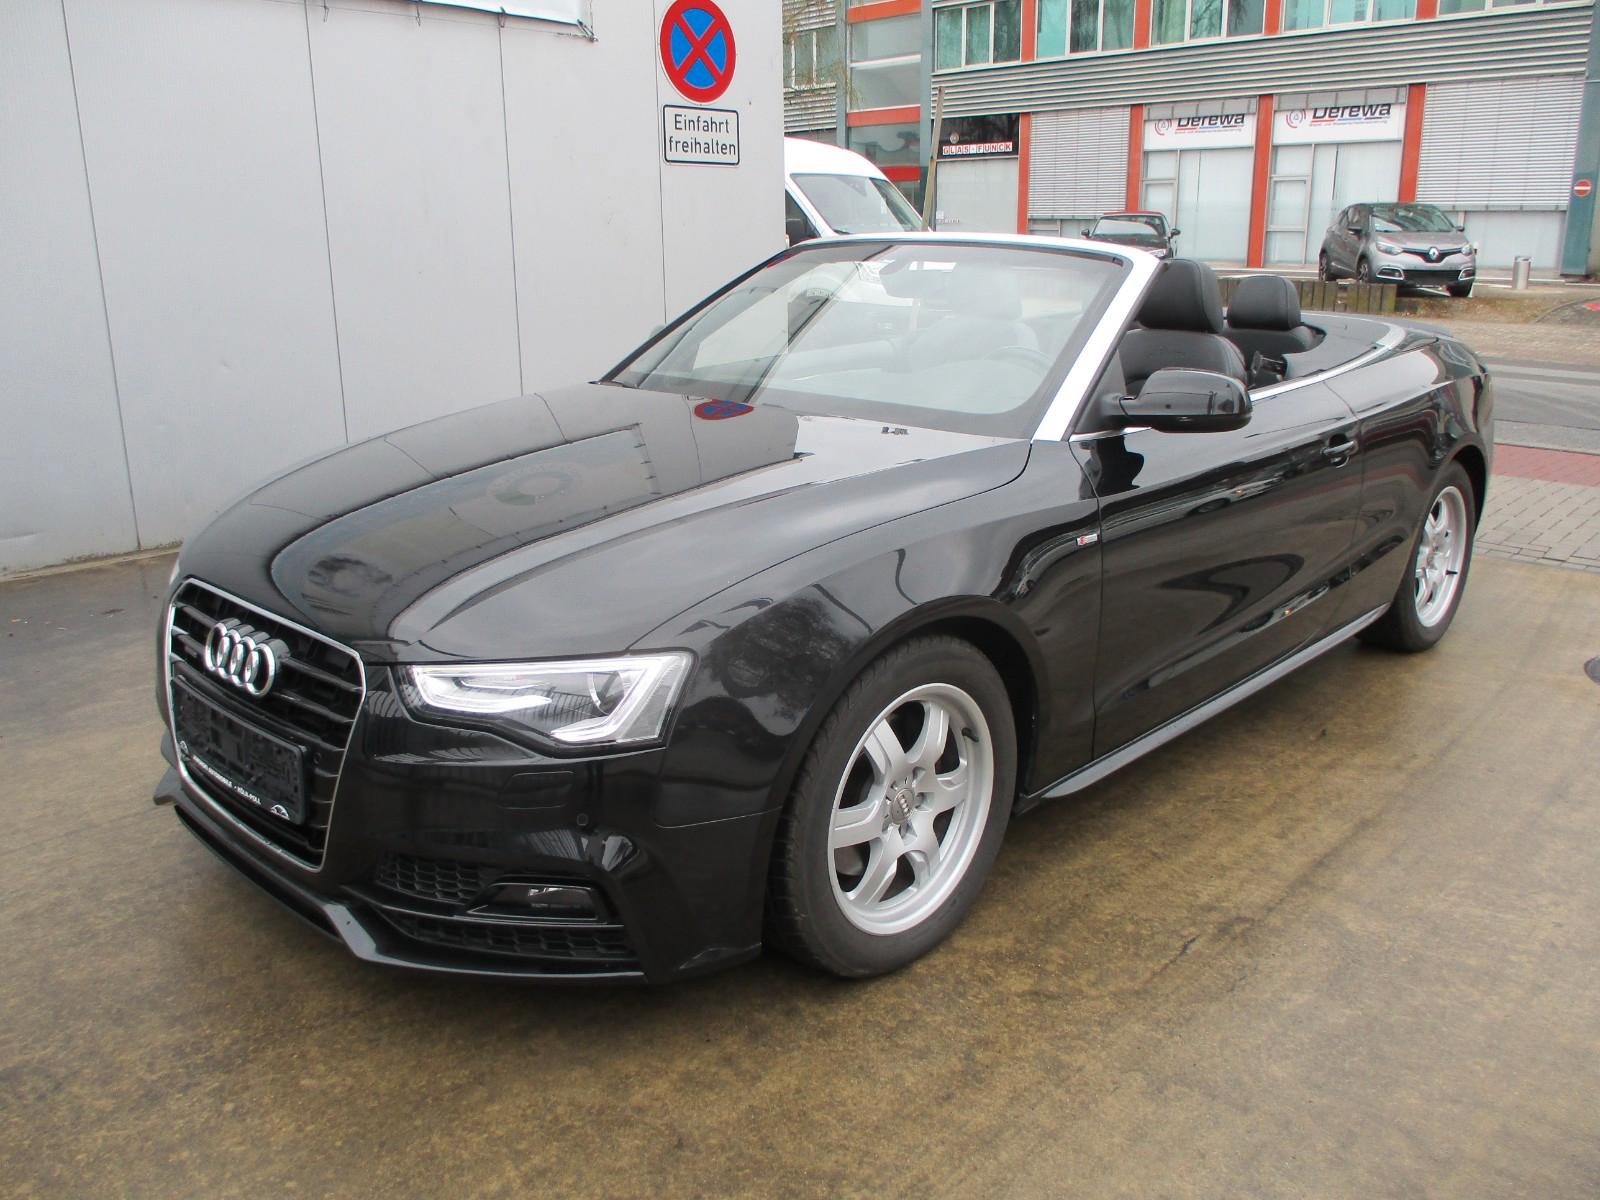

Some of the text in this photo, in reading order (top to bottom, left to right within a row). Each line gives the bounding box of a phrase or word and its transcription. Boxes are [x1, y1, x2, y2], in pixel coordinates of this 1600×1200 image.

[1177, 113, 1245, 127] Derewa
[1312, 103, 1392, 119] Derewa
[674, 113, 730, 133] Einfahrt
[669, 135, 736, 155] freihalten
